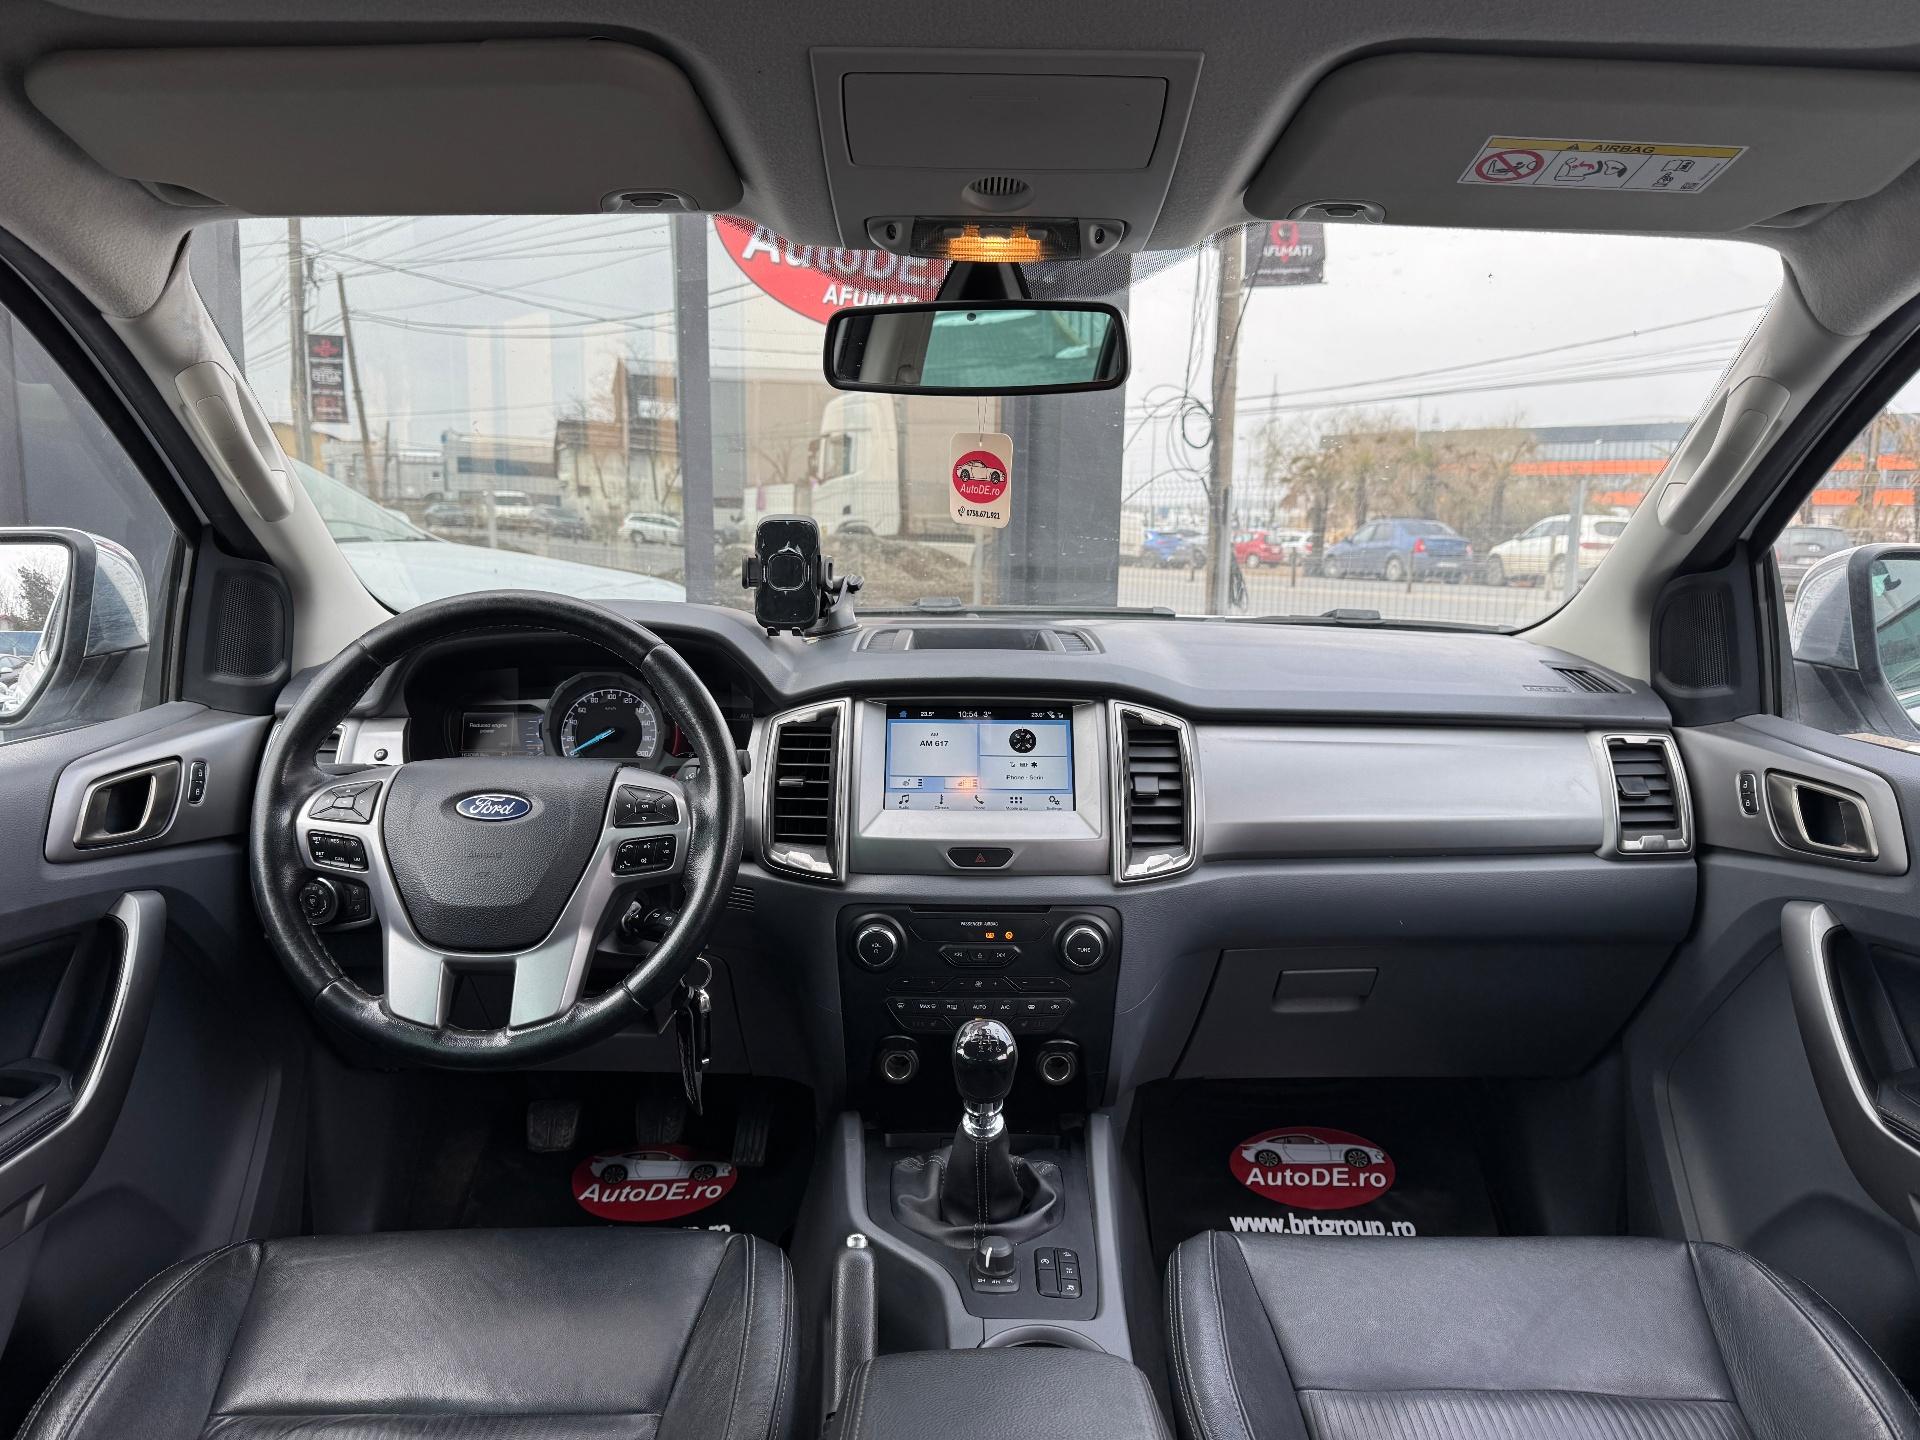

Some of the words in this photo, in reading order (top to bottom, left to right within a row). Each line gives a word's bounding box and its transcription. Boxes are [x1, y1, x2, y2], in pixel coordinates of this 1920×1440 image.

[1591, 143, 1656, 155] AIRBAG
[960, 484, 1001, 496] AutoDE.ro
[469, 796, 516, 815] Ford
[1245, 1167, 1387, 1188] AutoDE.ro
[578, 1182, 722, 1203] AutoDE.ro
[1229, 1212, 1416, 1237] www.brtgroup.ro
